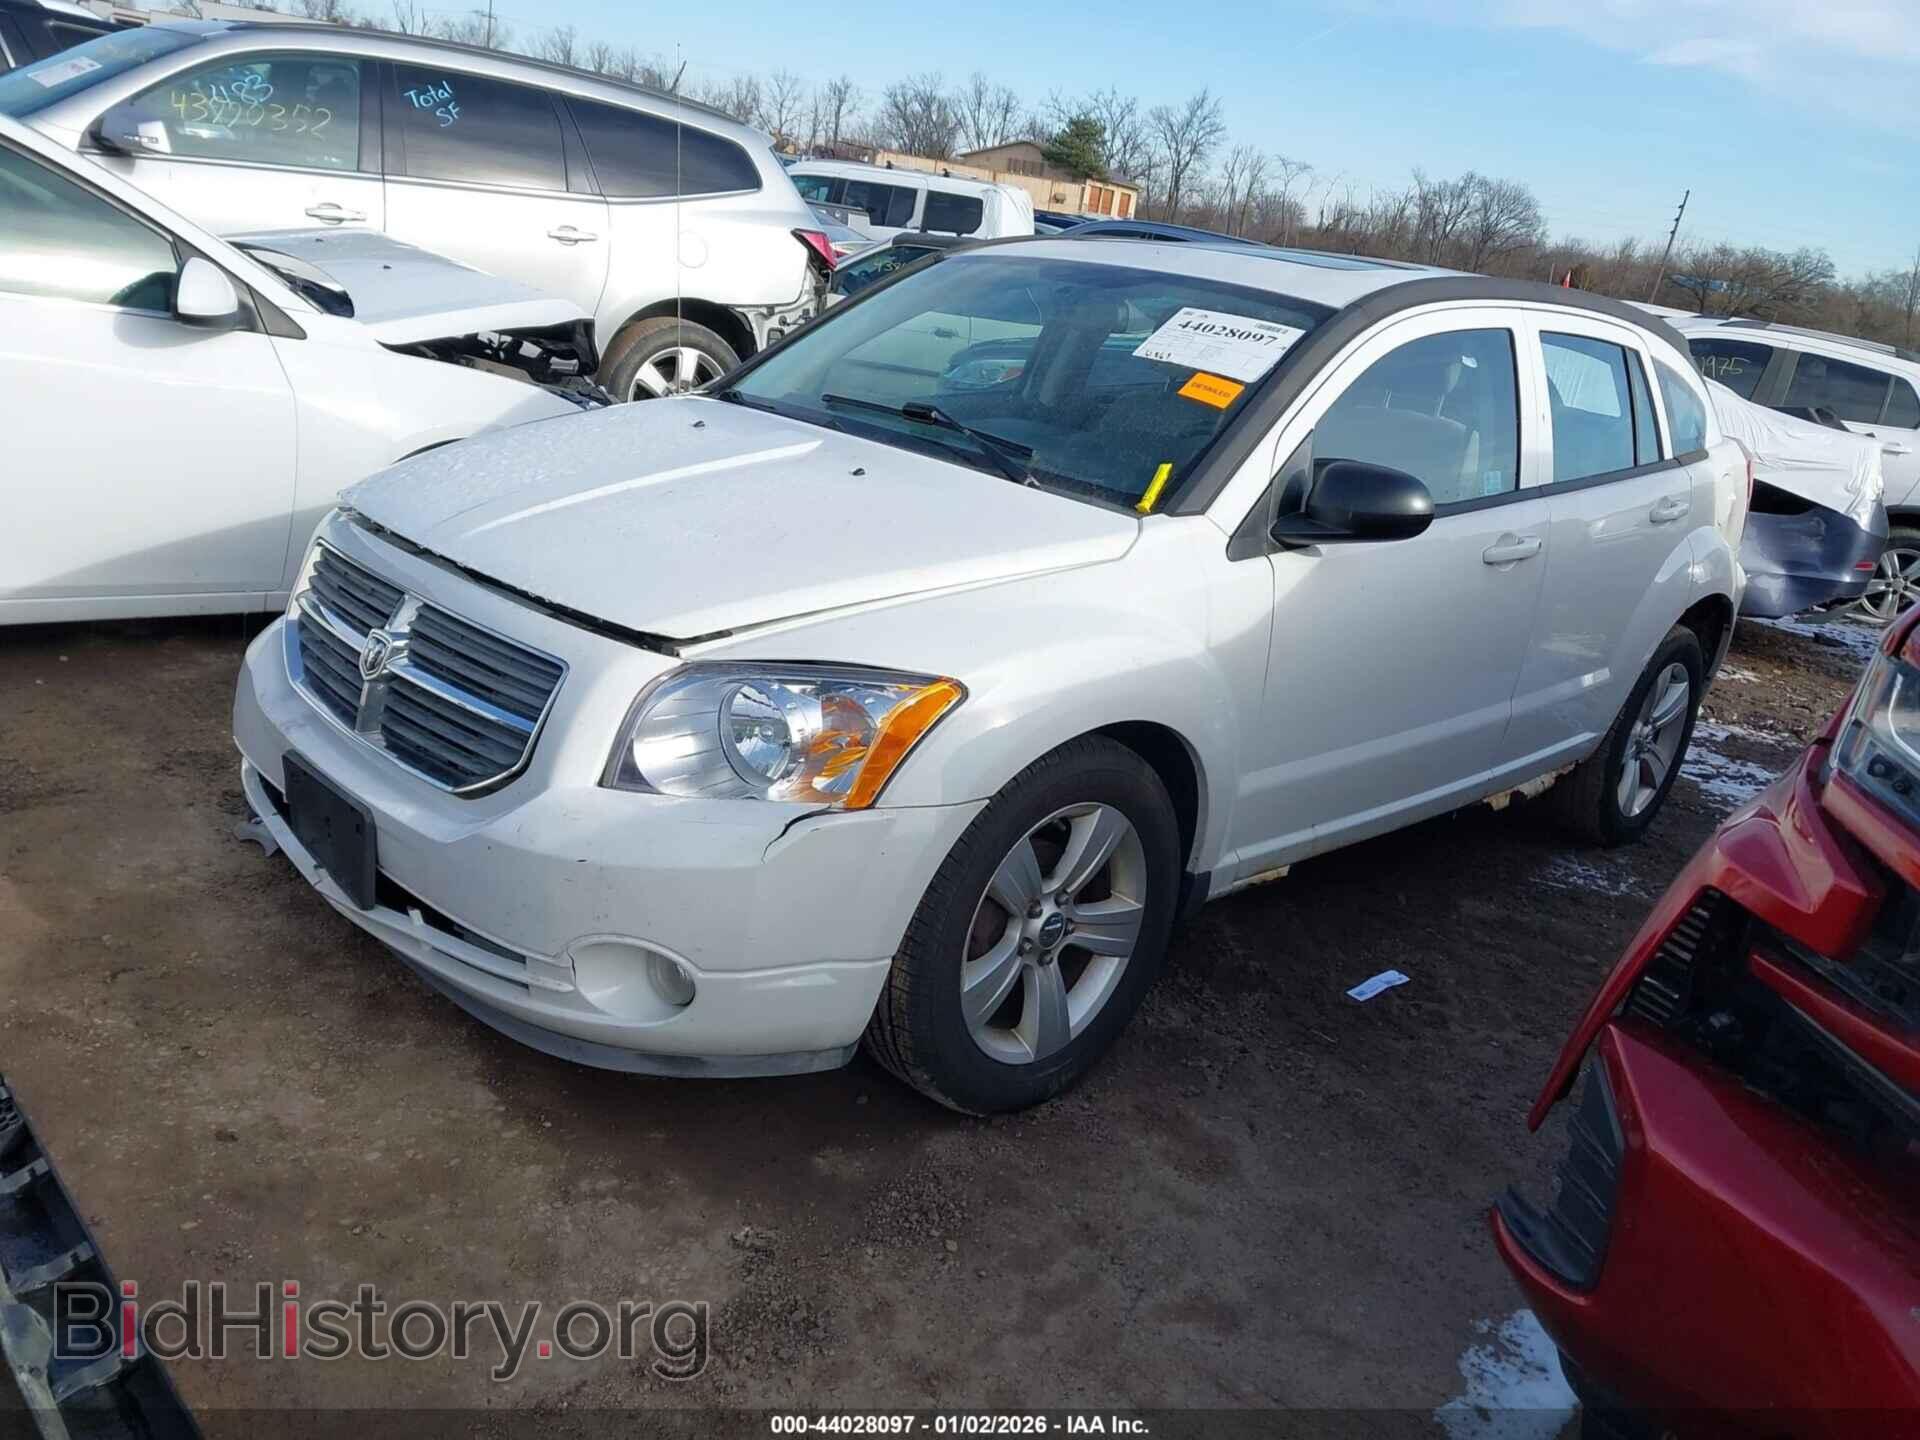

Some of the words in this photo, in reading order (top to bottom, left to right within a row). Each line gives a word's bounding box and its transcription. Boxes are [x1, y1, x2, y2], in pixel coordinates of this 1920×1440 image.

[403, 80, 453, 108] Total
[436, 101, 460, 127] SF
[1178, 319, 1279, 346] 44028097
